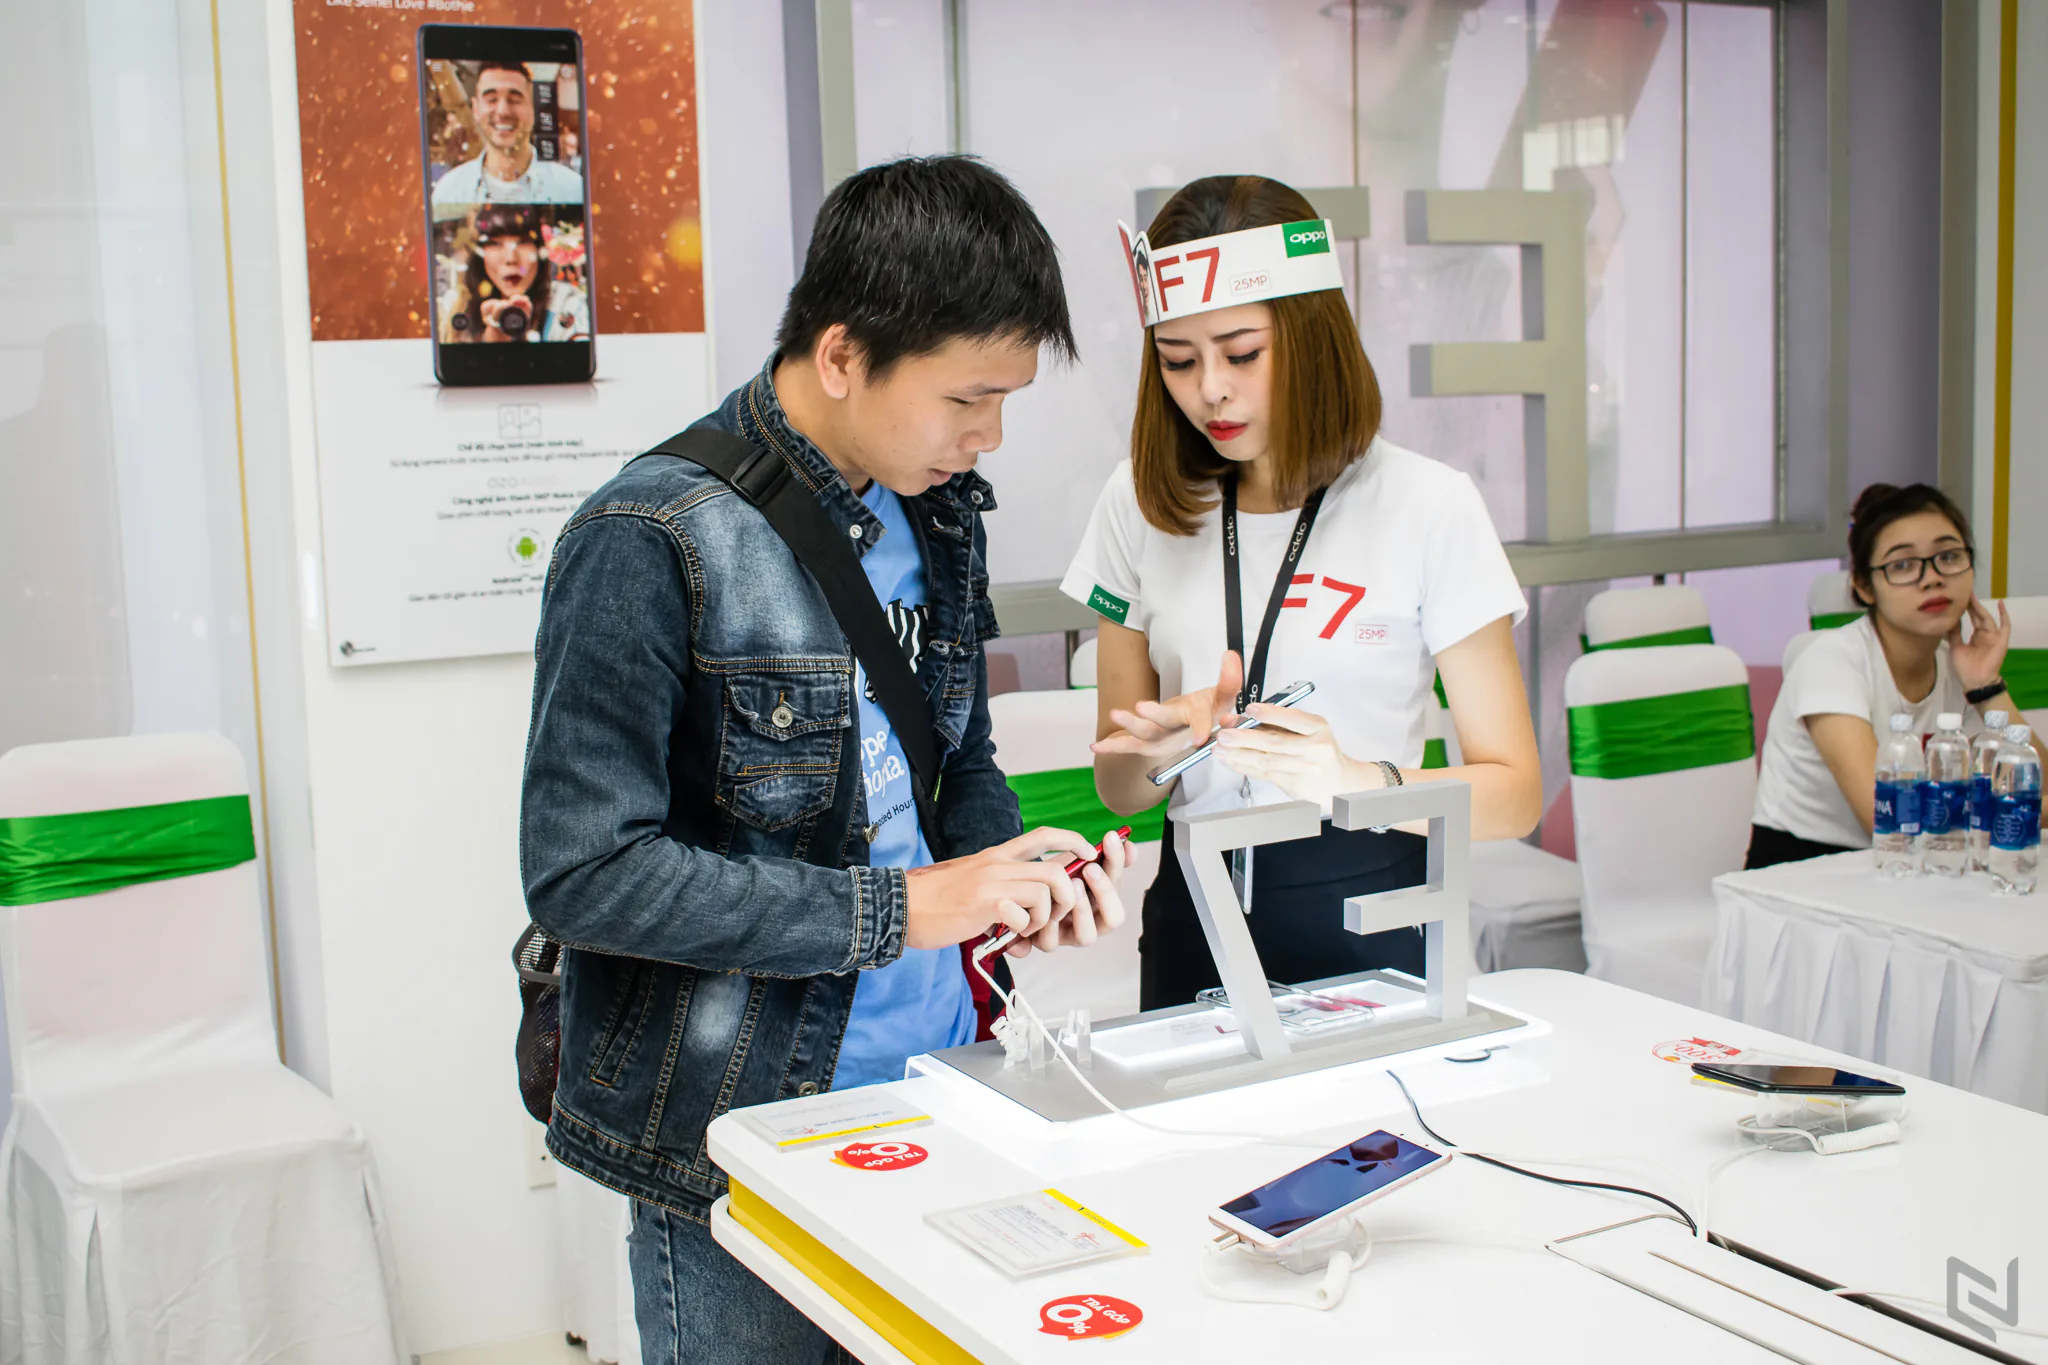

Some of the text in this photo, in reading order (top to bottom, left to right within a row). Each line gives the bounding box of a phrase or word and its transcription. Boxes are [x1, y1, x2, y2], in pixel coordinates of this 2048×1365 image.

[1289, 230, 1326, 245] oppo
[1153, 246, 1220, 313] F7
[1234, 274, 1267, 291] 25MP
[1227, 515, 1236, 557] oppo
[1288, 522, 1307, 562] oppo
[1093, 592, 1125, 615] oppo
[1358, 628, 1387, 641] 25MP
